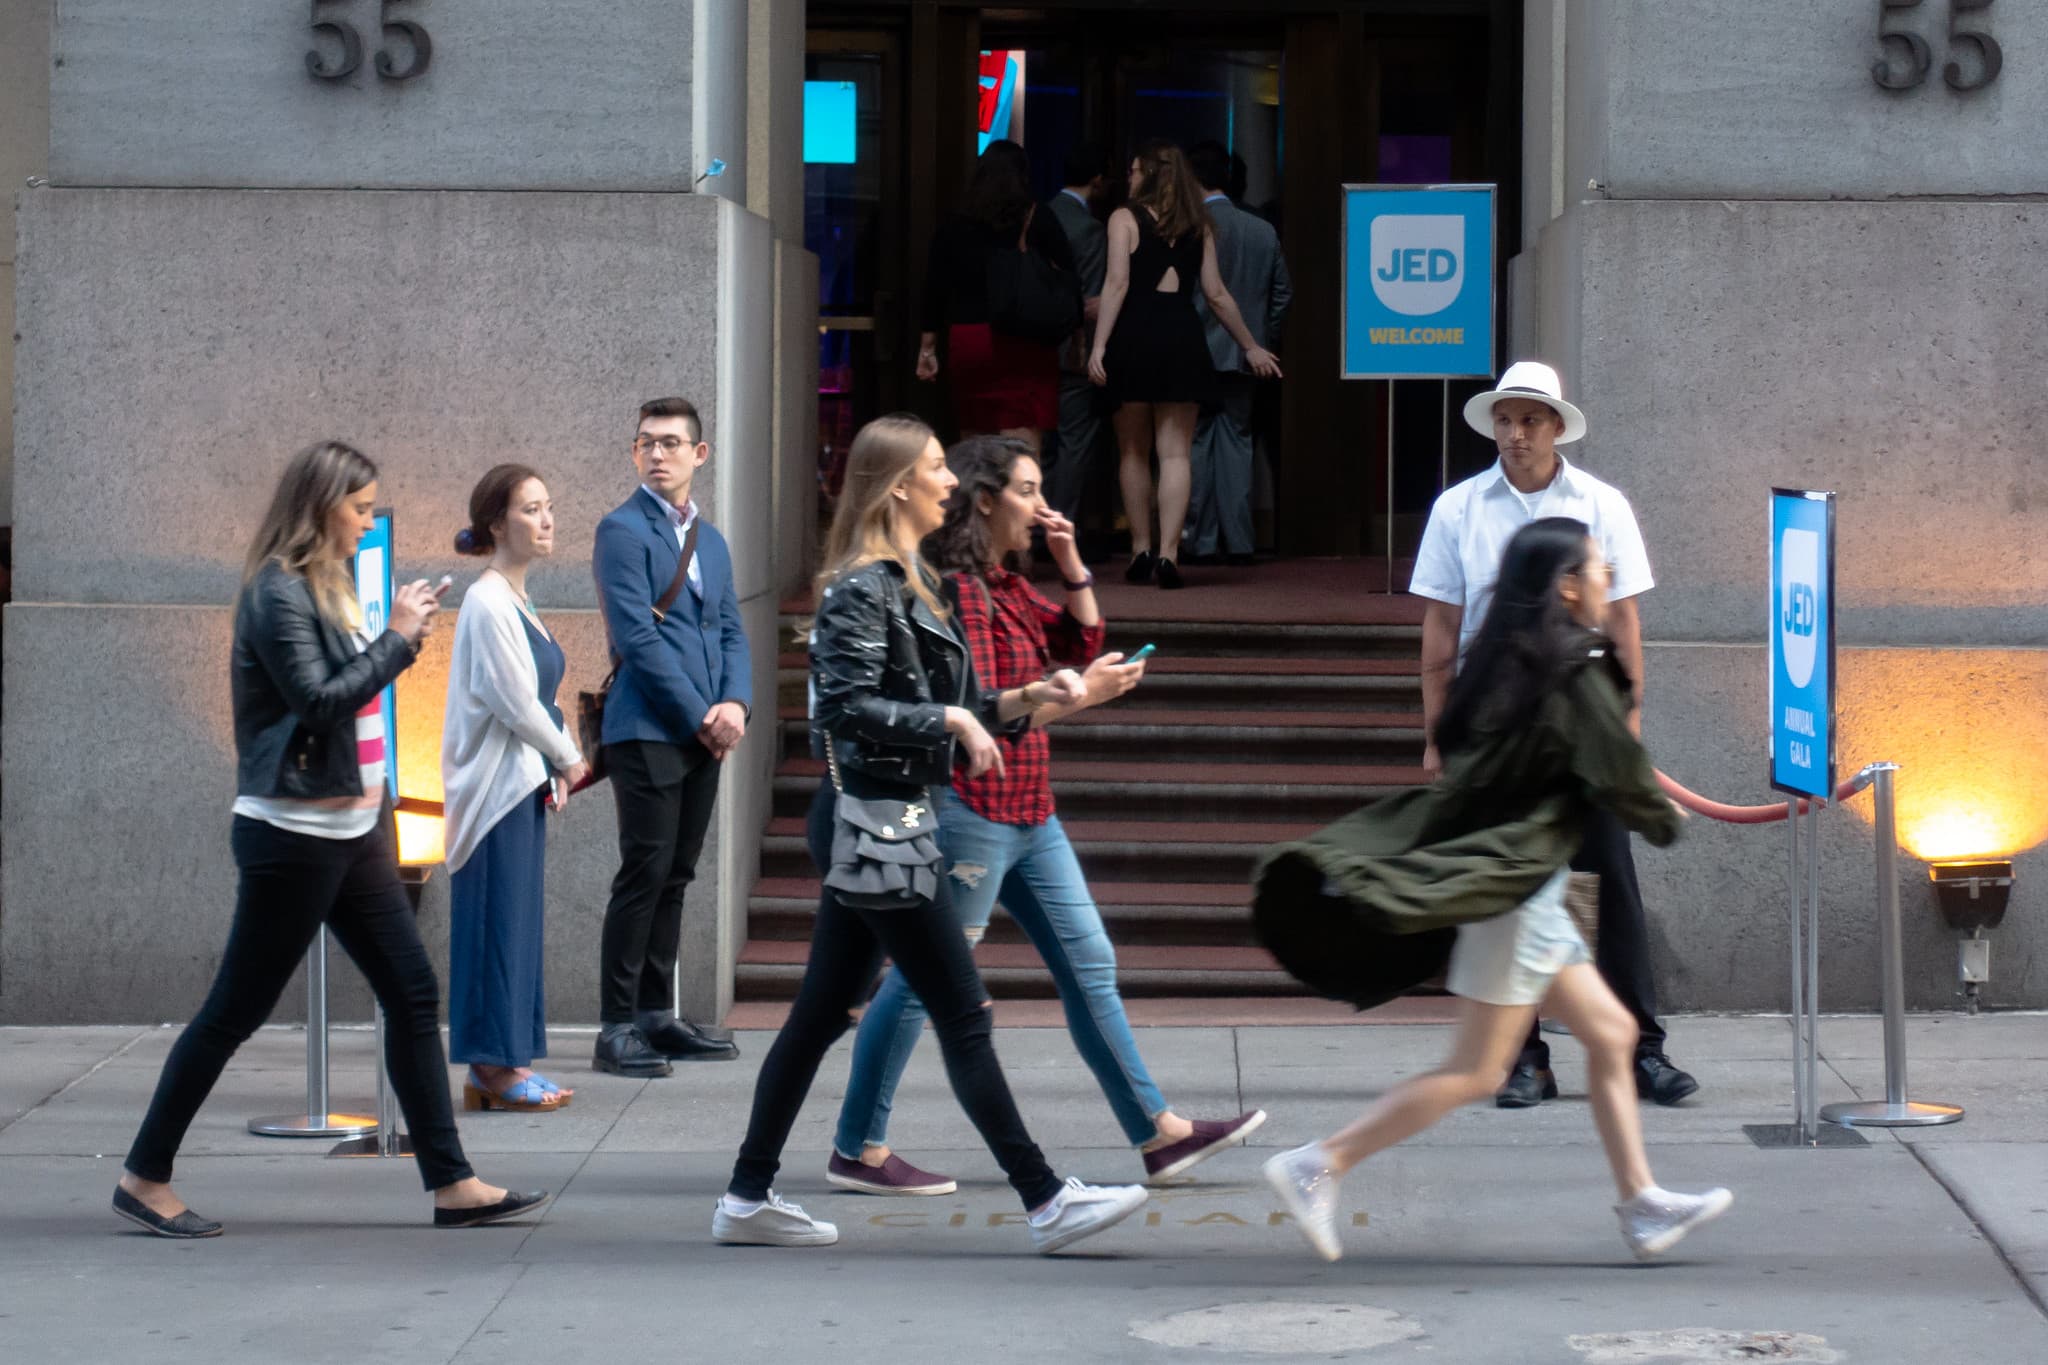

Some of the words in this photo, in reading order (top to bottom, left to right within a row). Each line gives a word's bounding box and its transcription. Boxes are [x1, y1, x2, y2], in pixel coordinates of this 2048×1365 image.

[304, 0, 432, 81] 55
[1871, 0, 2004, 91] 55
[1377, 248, 1458, 282] JED
[1369, 327, 1465, 345] WELCOME
[1784, 581, 1814, 637] JED
[1784, 705, 1816, 738] ANNUAL
[1790, 740, 1811, 769] GALA
[867, 1211, 1369, 1228] CIPIAI
